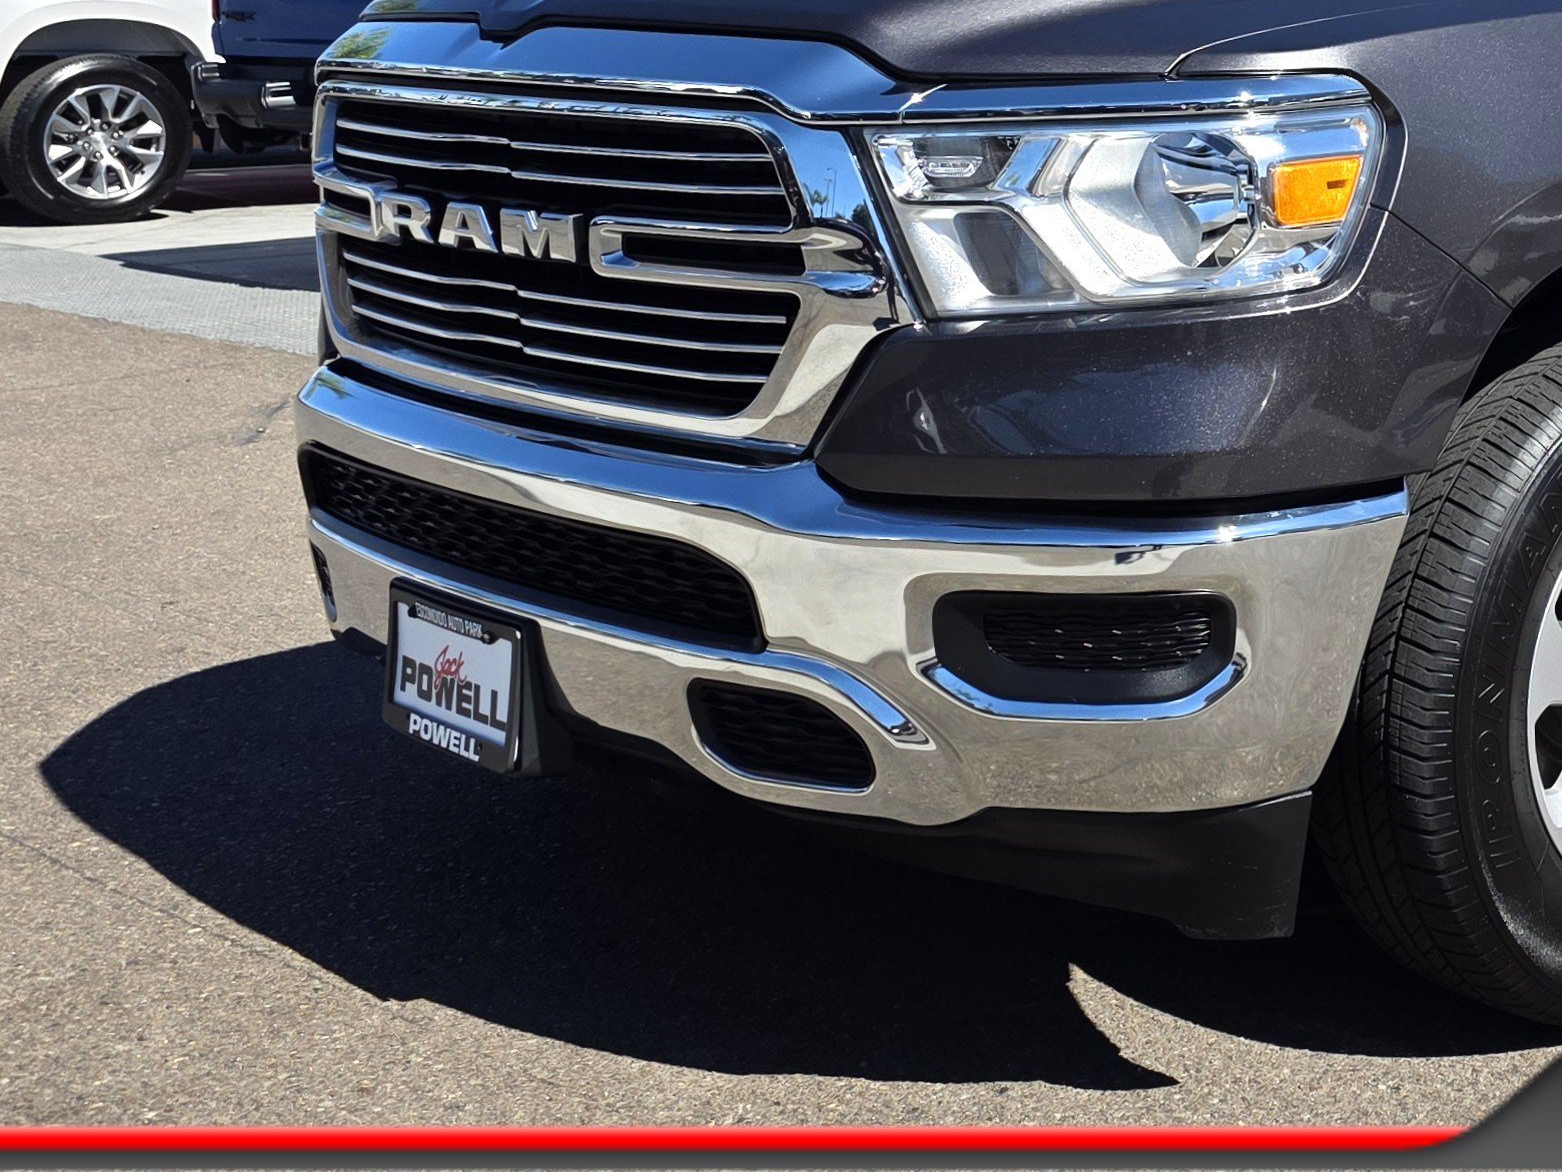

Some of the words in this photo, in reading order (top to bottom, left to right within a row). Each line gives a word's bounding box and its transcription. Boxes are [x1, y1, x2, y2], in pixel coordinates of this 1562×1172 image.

[380, 191, 584, 264] RAM
[400, 654, 508, 728] POWELL
[434, 645, 469, 693] Jack
[409, 712, 480, 763] POWELL
